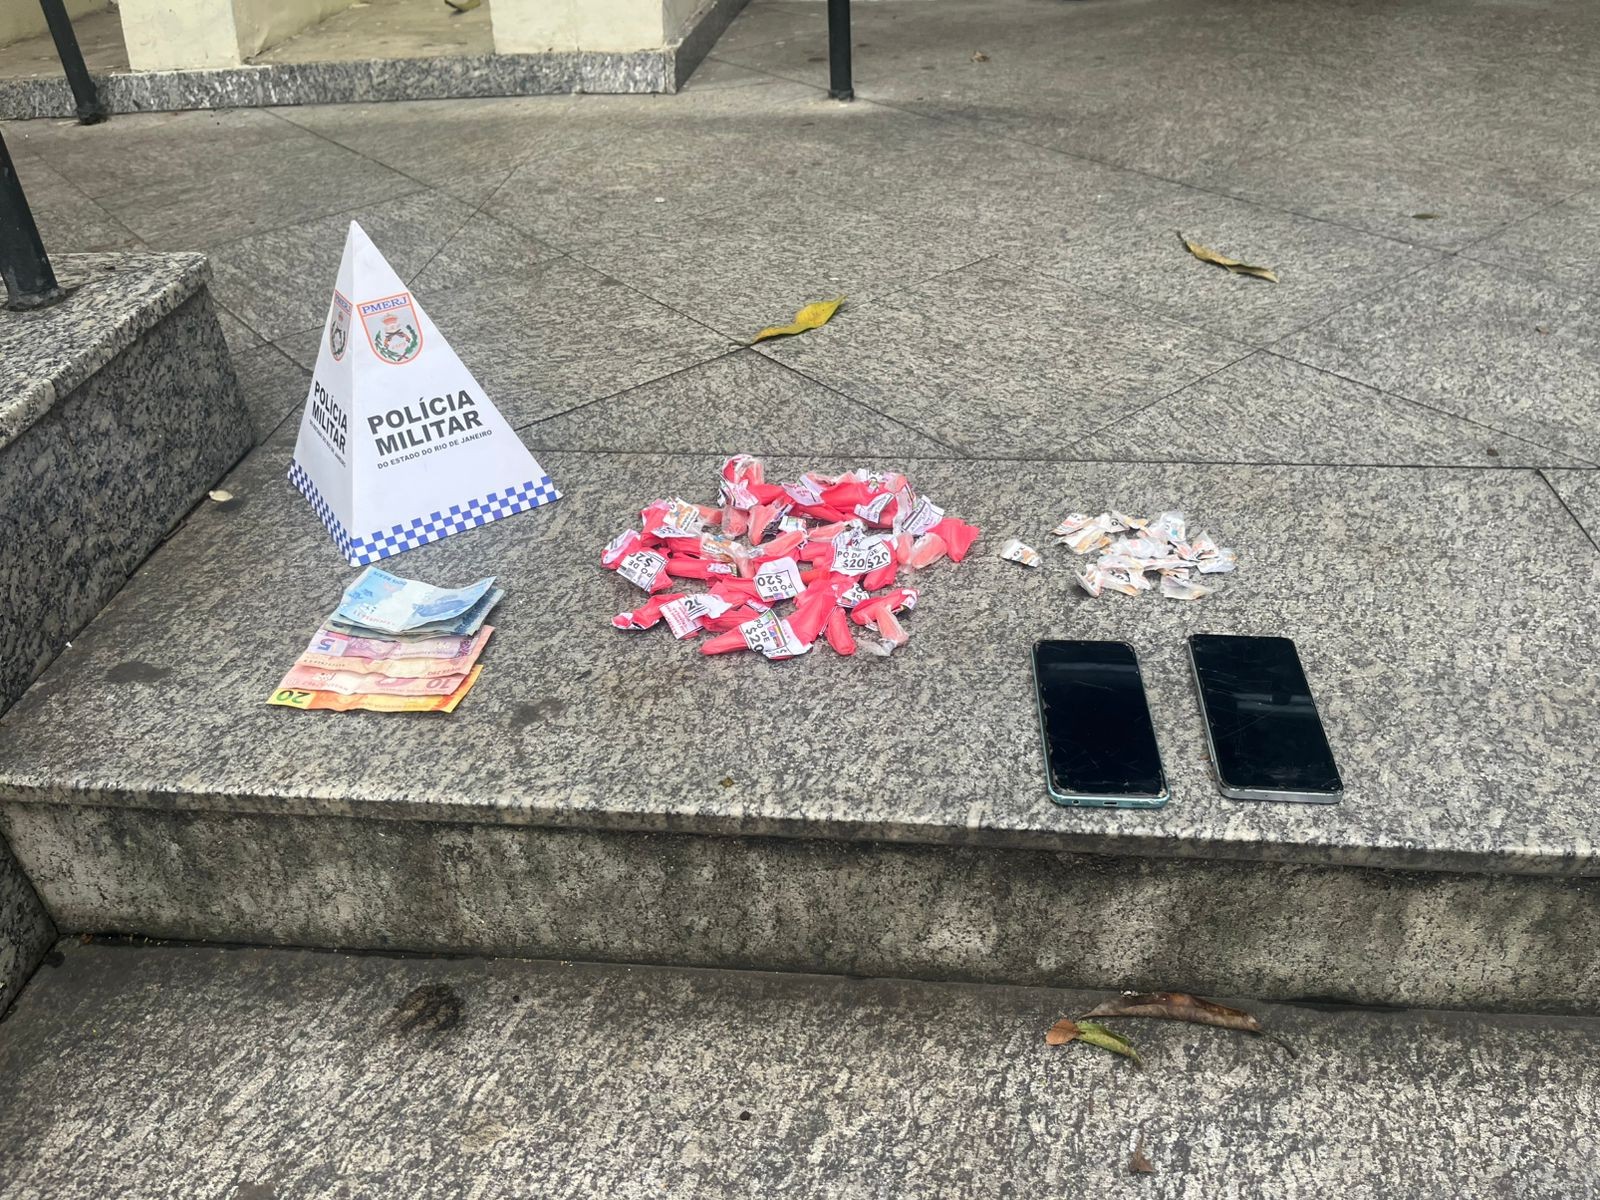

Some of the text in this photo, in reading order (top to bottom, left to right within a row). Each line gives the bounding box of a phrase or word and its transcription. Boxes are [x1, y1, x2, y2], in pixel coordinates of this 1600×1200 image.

[362, 297, 407, 313] PMERJ
[314, 380, 347, 433] POLÍCIA
[367, 390, 475, 435] POLÍCIA
[312, 401, 346, 454] MILITAR
[375, 410, 483, 456] MILITAR
[377, 461, 389, 469] DO
[390, 451, 420, 465] ESTADO
[421, 447, 433, 456] DO
[434, 443, 448, 452] RIO
[461, 429, 493, 444] JANEIRO
[757, 574, 782, 587] $20
[318, 638, 335, 650] 5
[760, 631, 770, 642] DE
[426, 678, 451, 689] 10
[276, 690, 311, 704] 20
